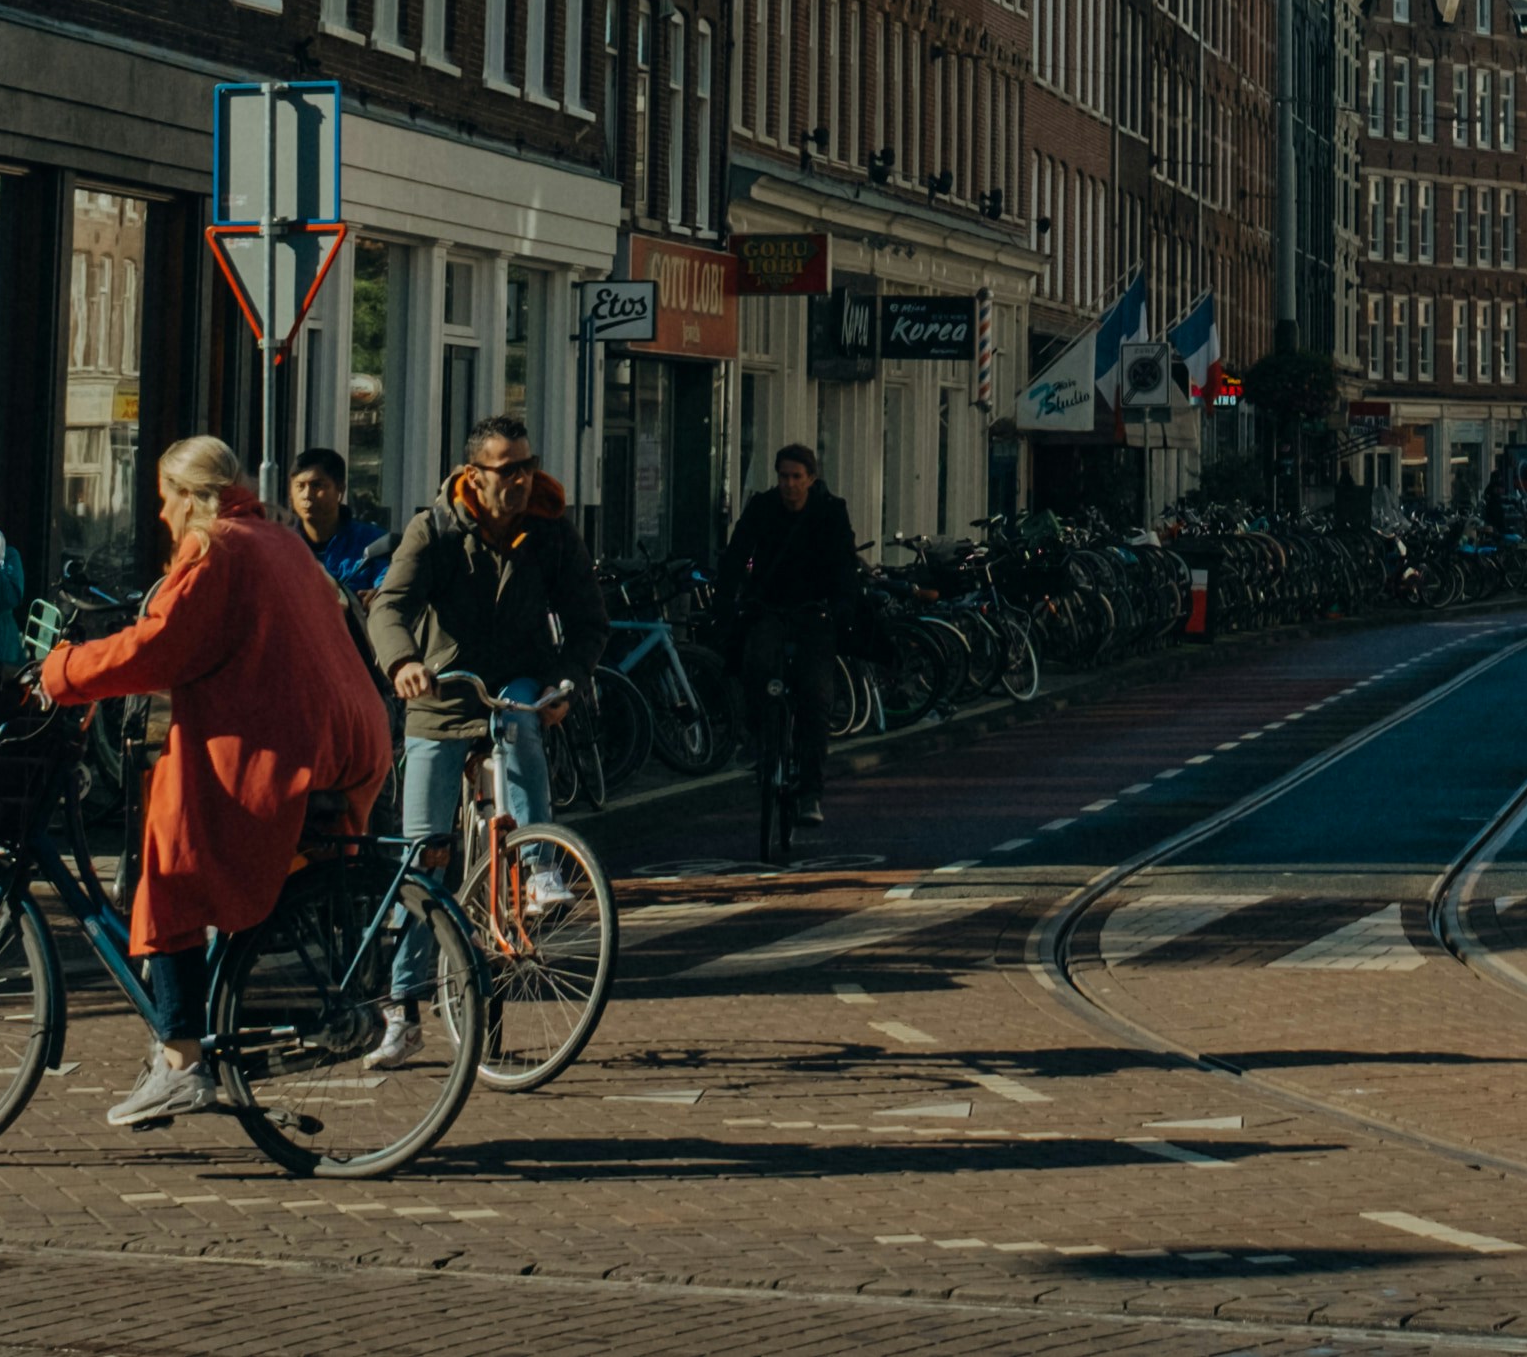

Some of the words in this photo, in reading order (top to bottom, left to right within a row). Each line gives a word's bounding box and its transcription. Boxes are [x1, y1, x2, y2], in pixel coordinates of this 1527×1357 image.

[747, 258, 804, 274] LOBI
[692, 260, 725, 316] LOBI
[593, 288, 648, 320] Etos
[889, 315, 968, 346] Korea
